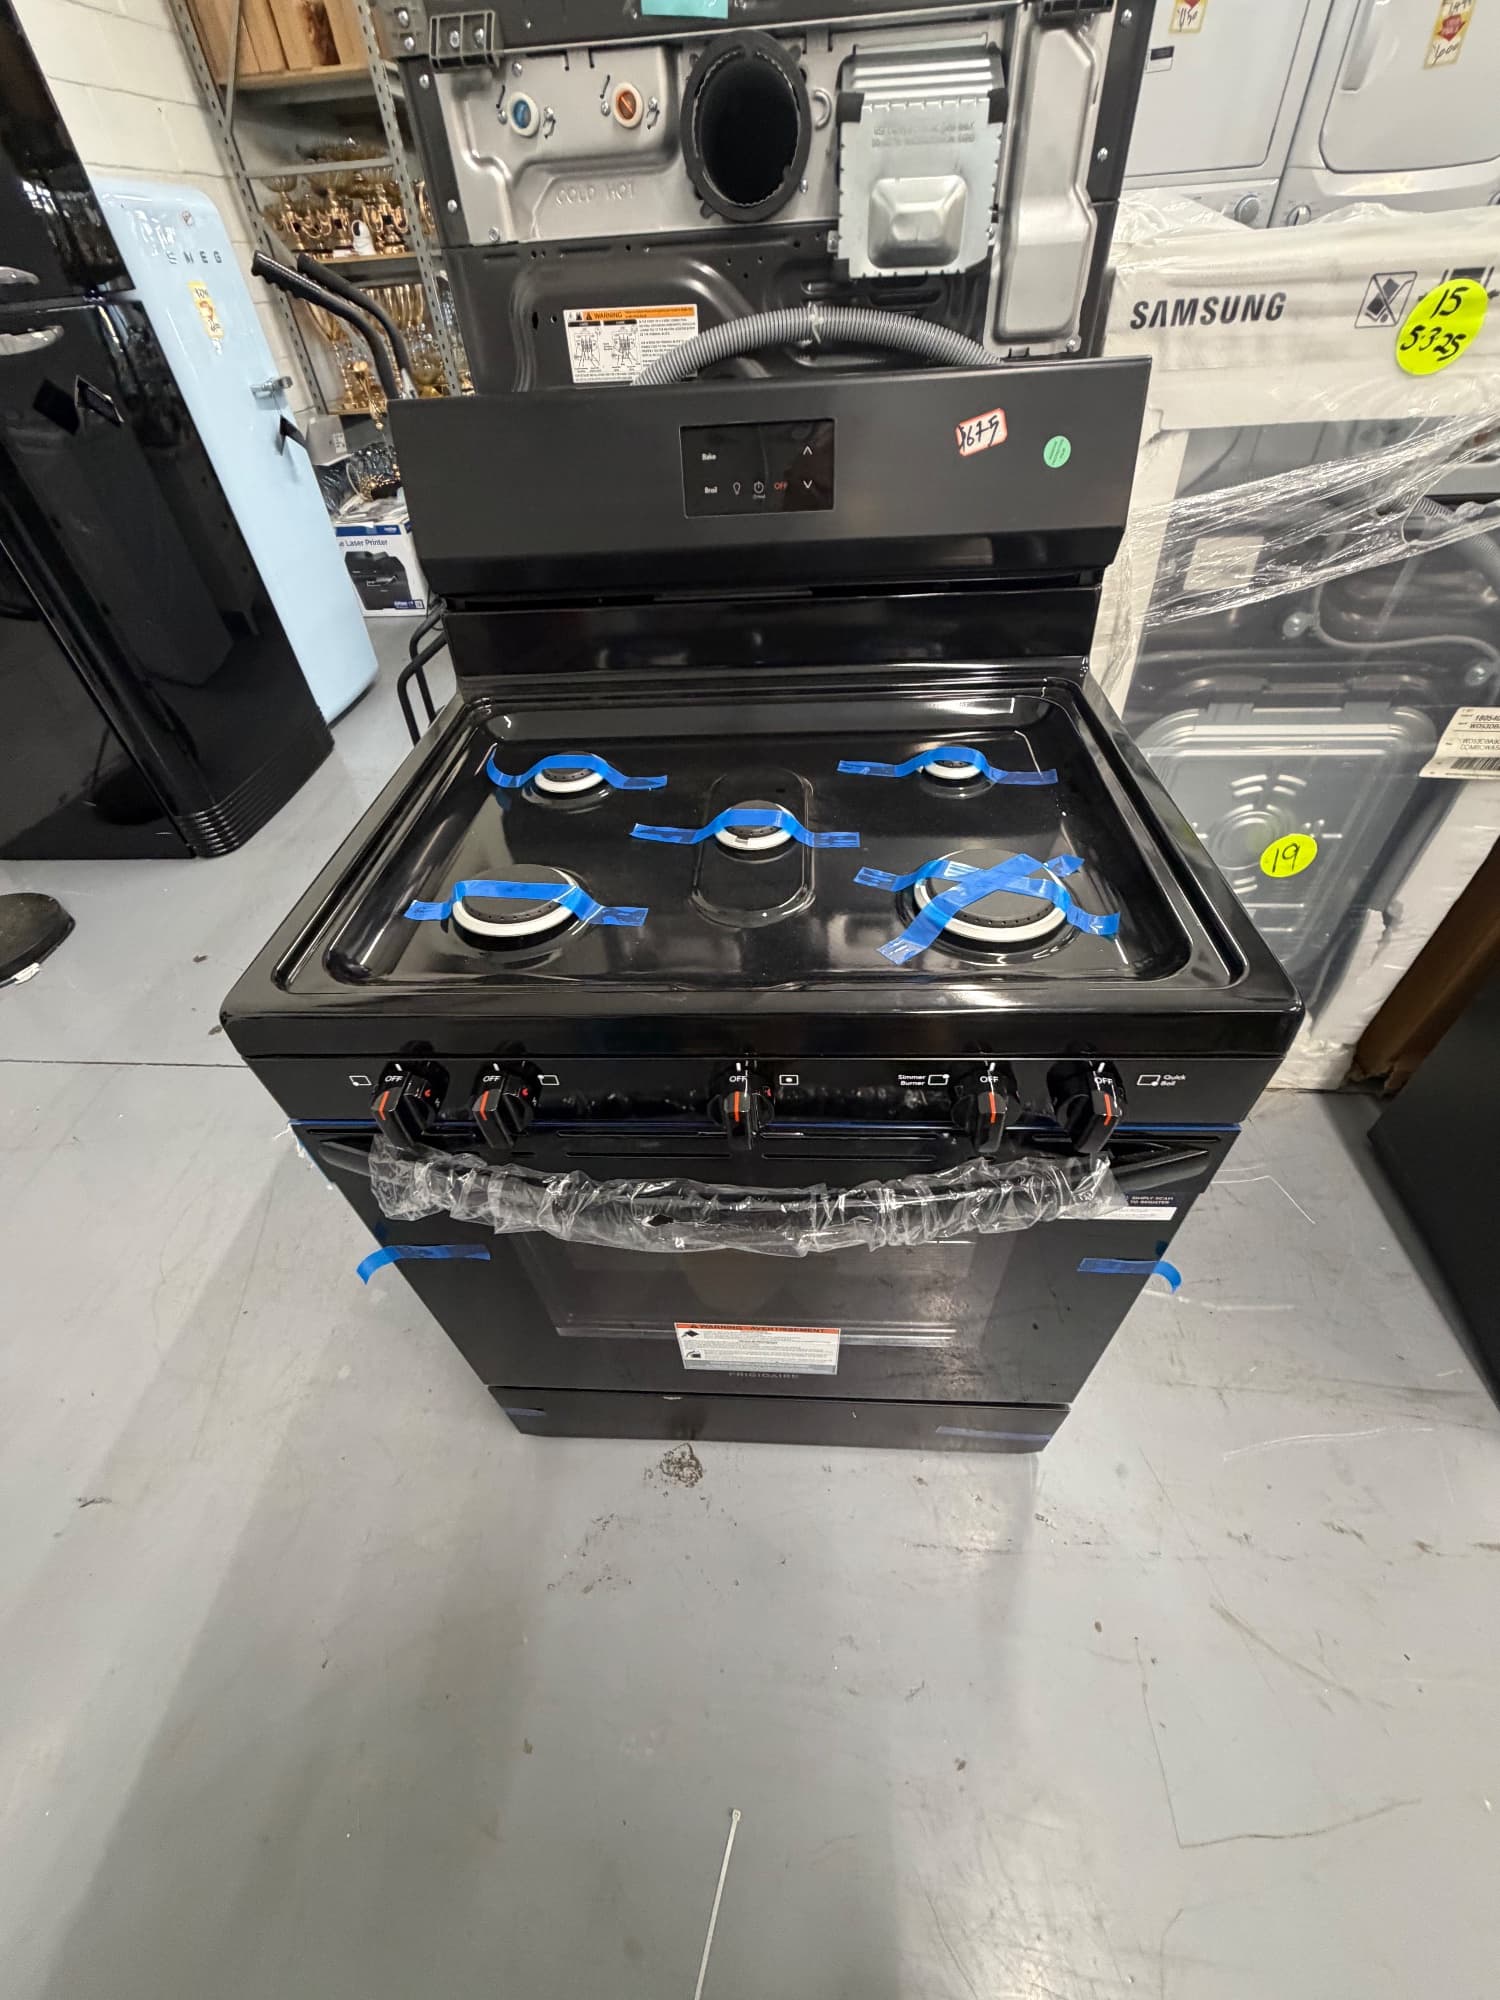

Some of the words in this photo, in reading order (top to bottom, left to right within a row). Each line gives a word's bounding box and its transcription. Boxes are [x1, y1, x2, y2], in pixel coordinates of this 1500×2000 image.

[165, 251, 223, 265] SMEG
[1429, 286, 1470, 319] 15
[1130, 292, 1287, 330] SAMSUNG
[593, 311, 623, 320] WARNING
[1272, 842, 1301, 873] 19
[385, 1075, 403, 1083] OFF
[483, 1075, 501, 1083] OFF
[729, 1075, 747, 1083] OFF
[979, 1075, 999, 1083] OFF
[1094, 1077, 1113, 1085] OFF
